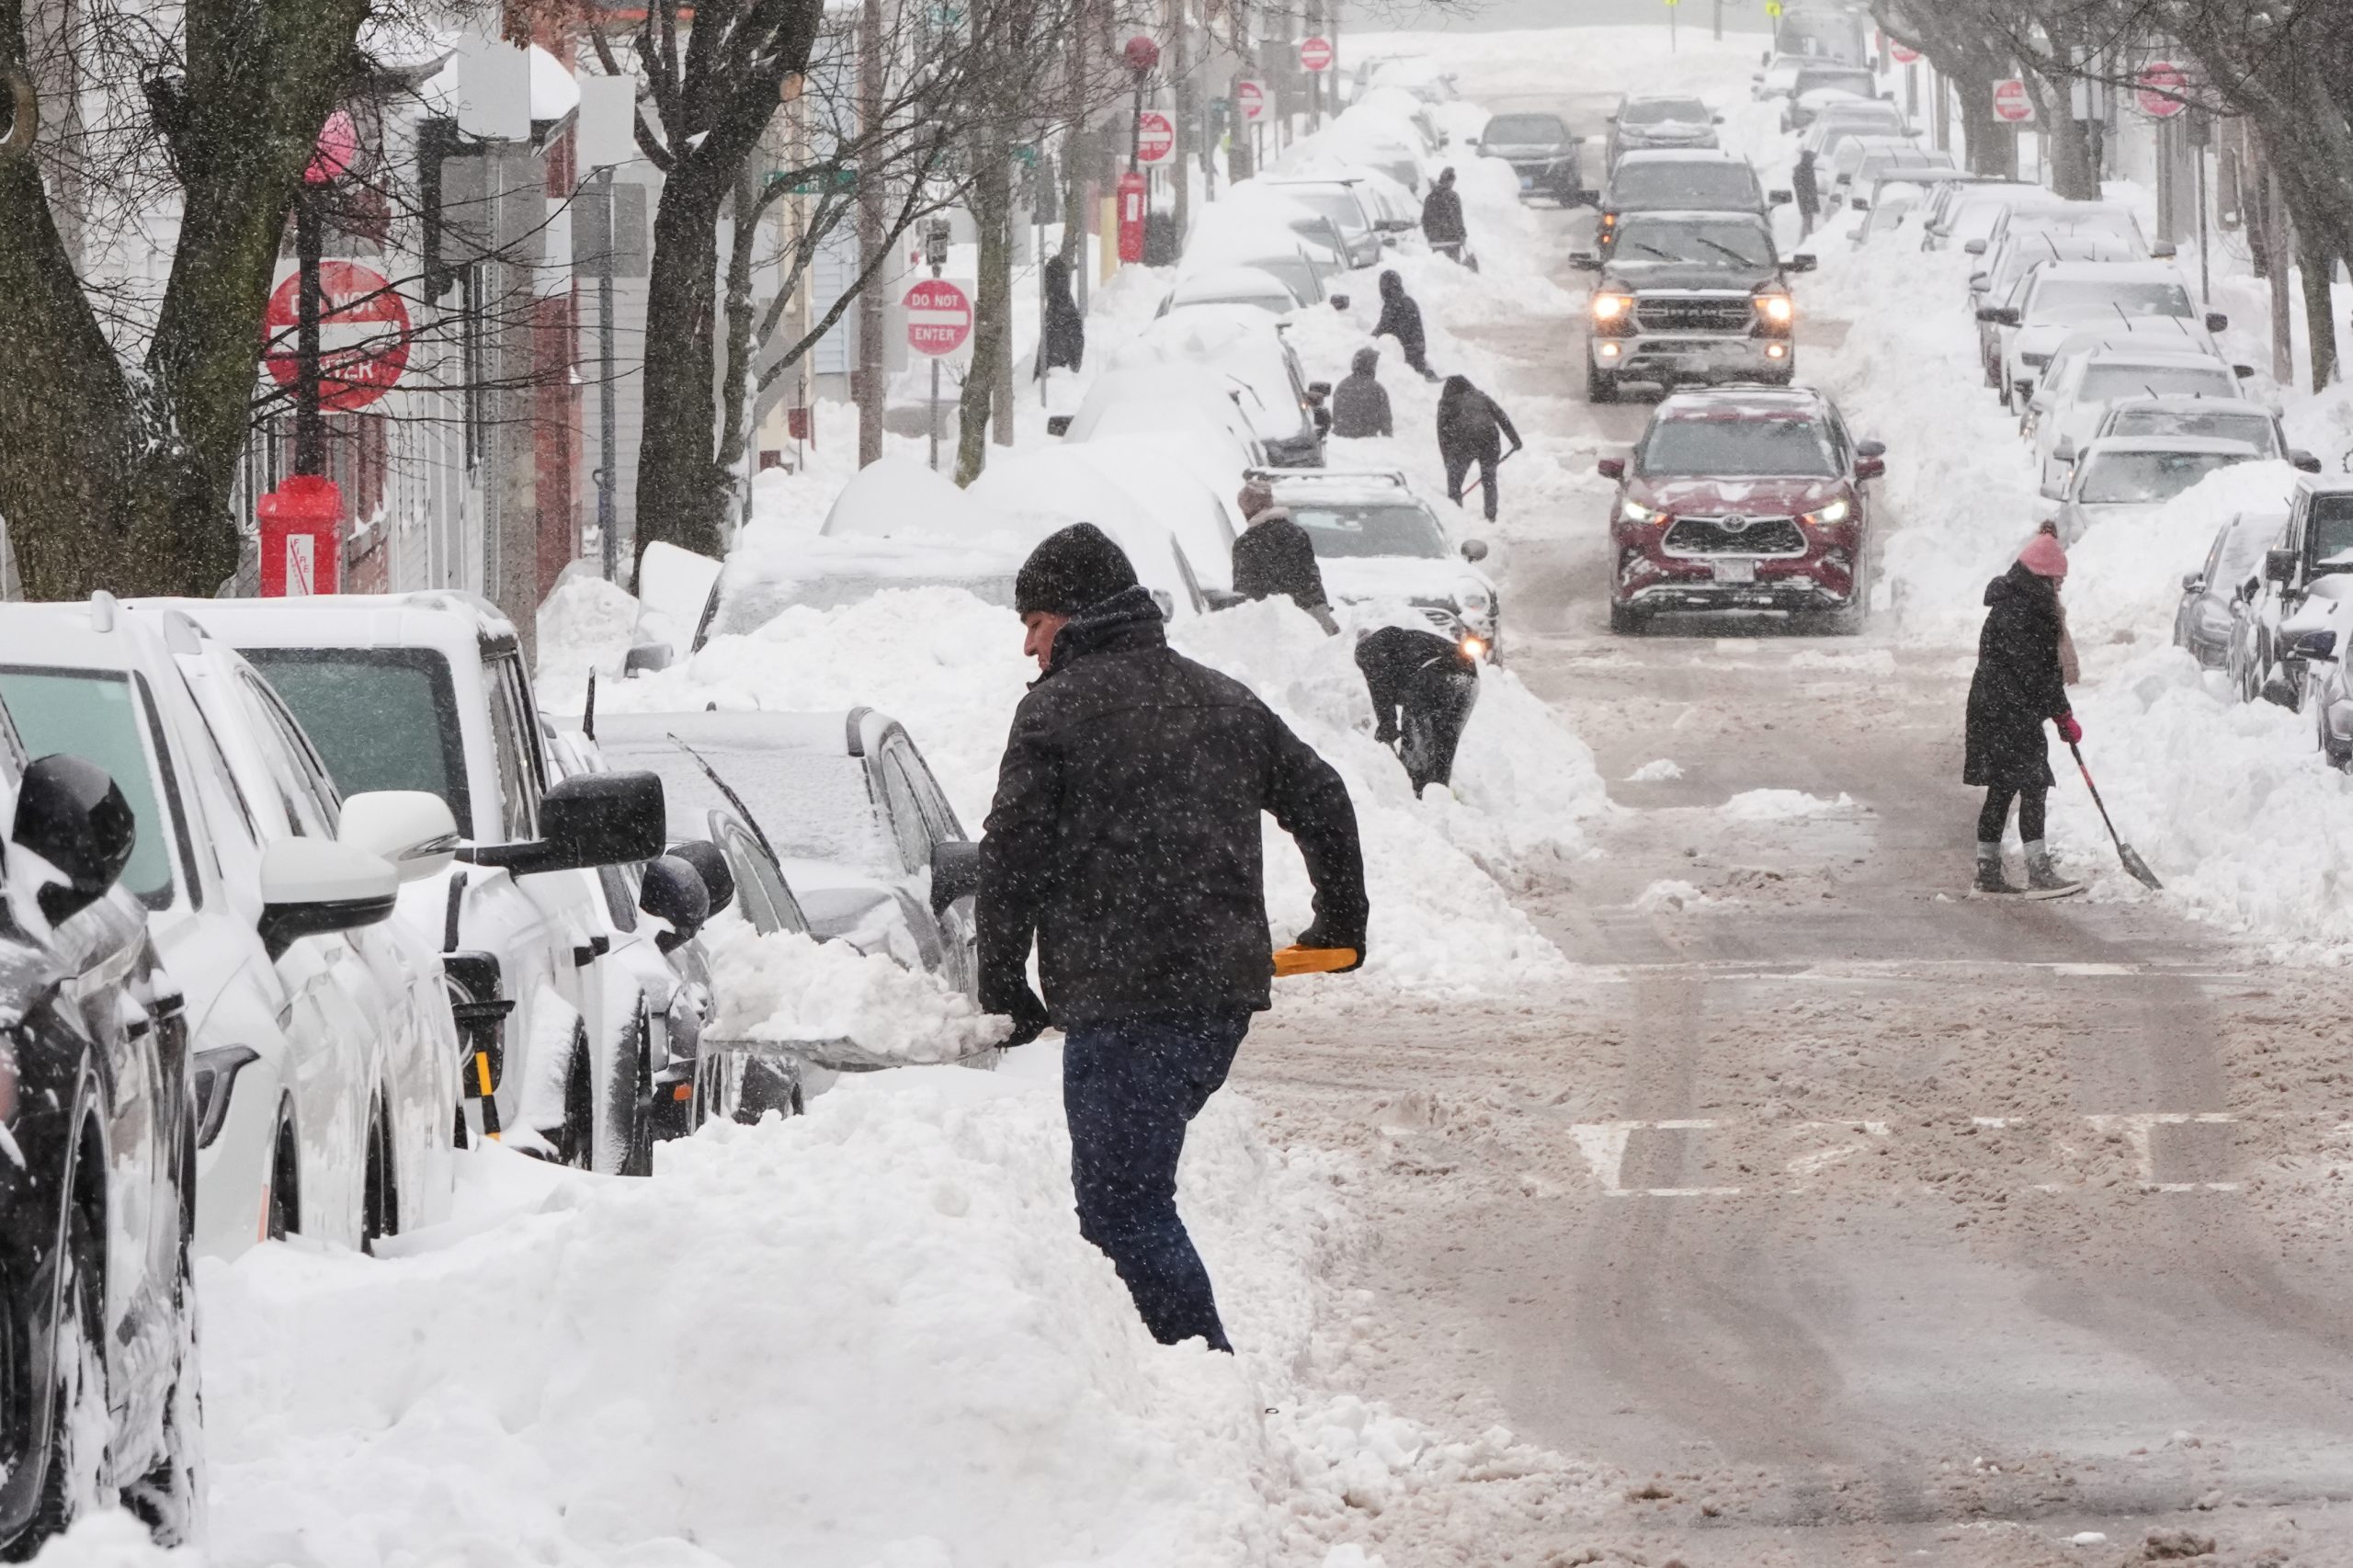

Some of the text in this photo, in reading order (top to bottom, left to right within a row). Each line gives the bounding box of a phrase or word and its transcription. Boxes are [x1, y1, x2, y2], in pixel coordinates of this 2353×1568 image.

[912, 293, 959, 307] DO NOT
[915, 328, 955, 341] ENTER
[293, 538, 310, 574] FIRE
